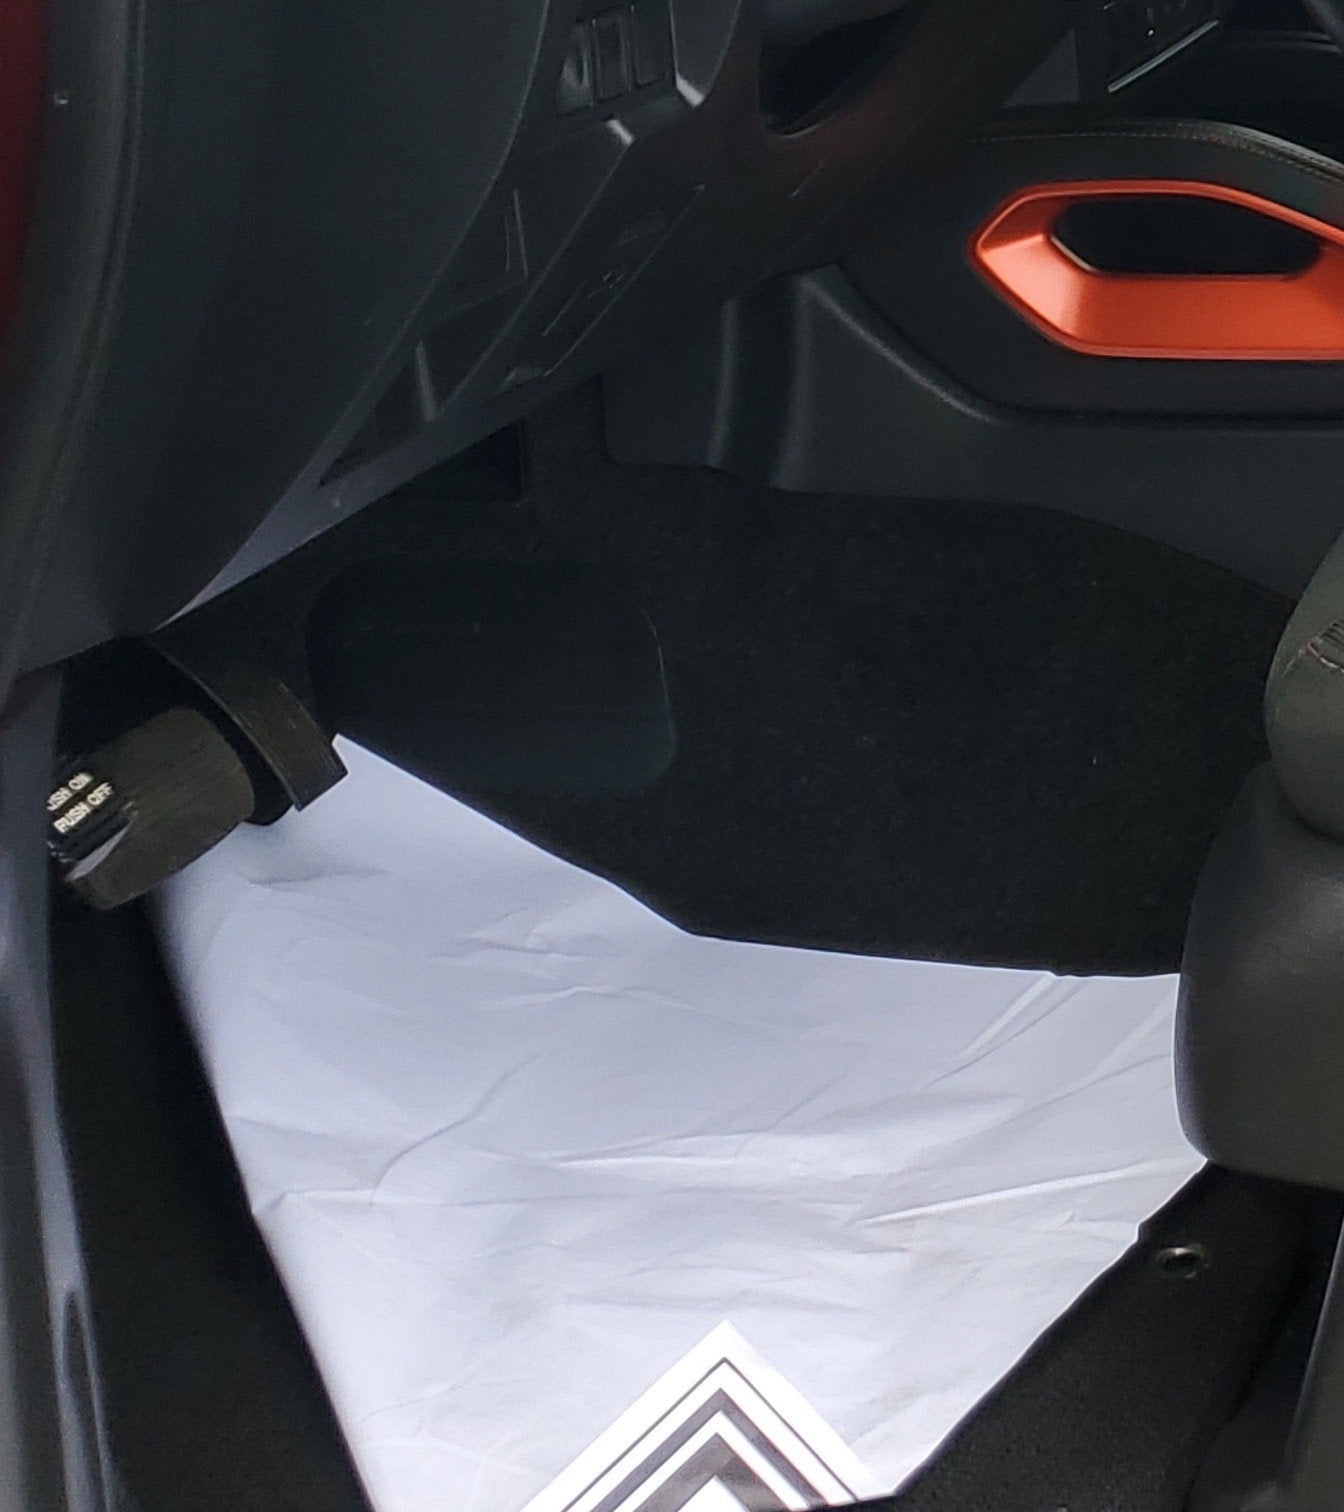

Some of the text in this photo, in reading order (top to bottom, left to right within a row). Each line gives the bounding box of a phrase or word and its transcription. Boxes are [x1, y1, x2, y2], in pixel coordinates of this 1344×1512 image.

[46, 772, 94, 811] USH ON
[53, 782, 112, 833] PUSH OFF
